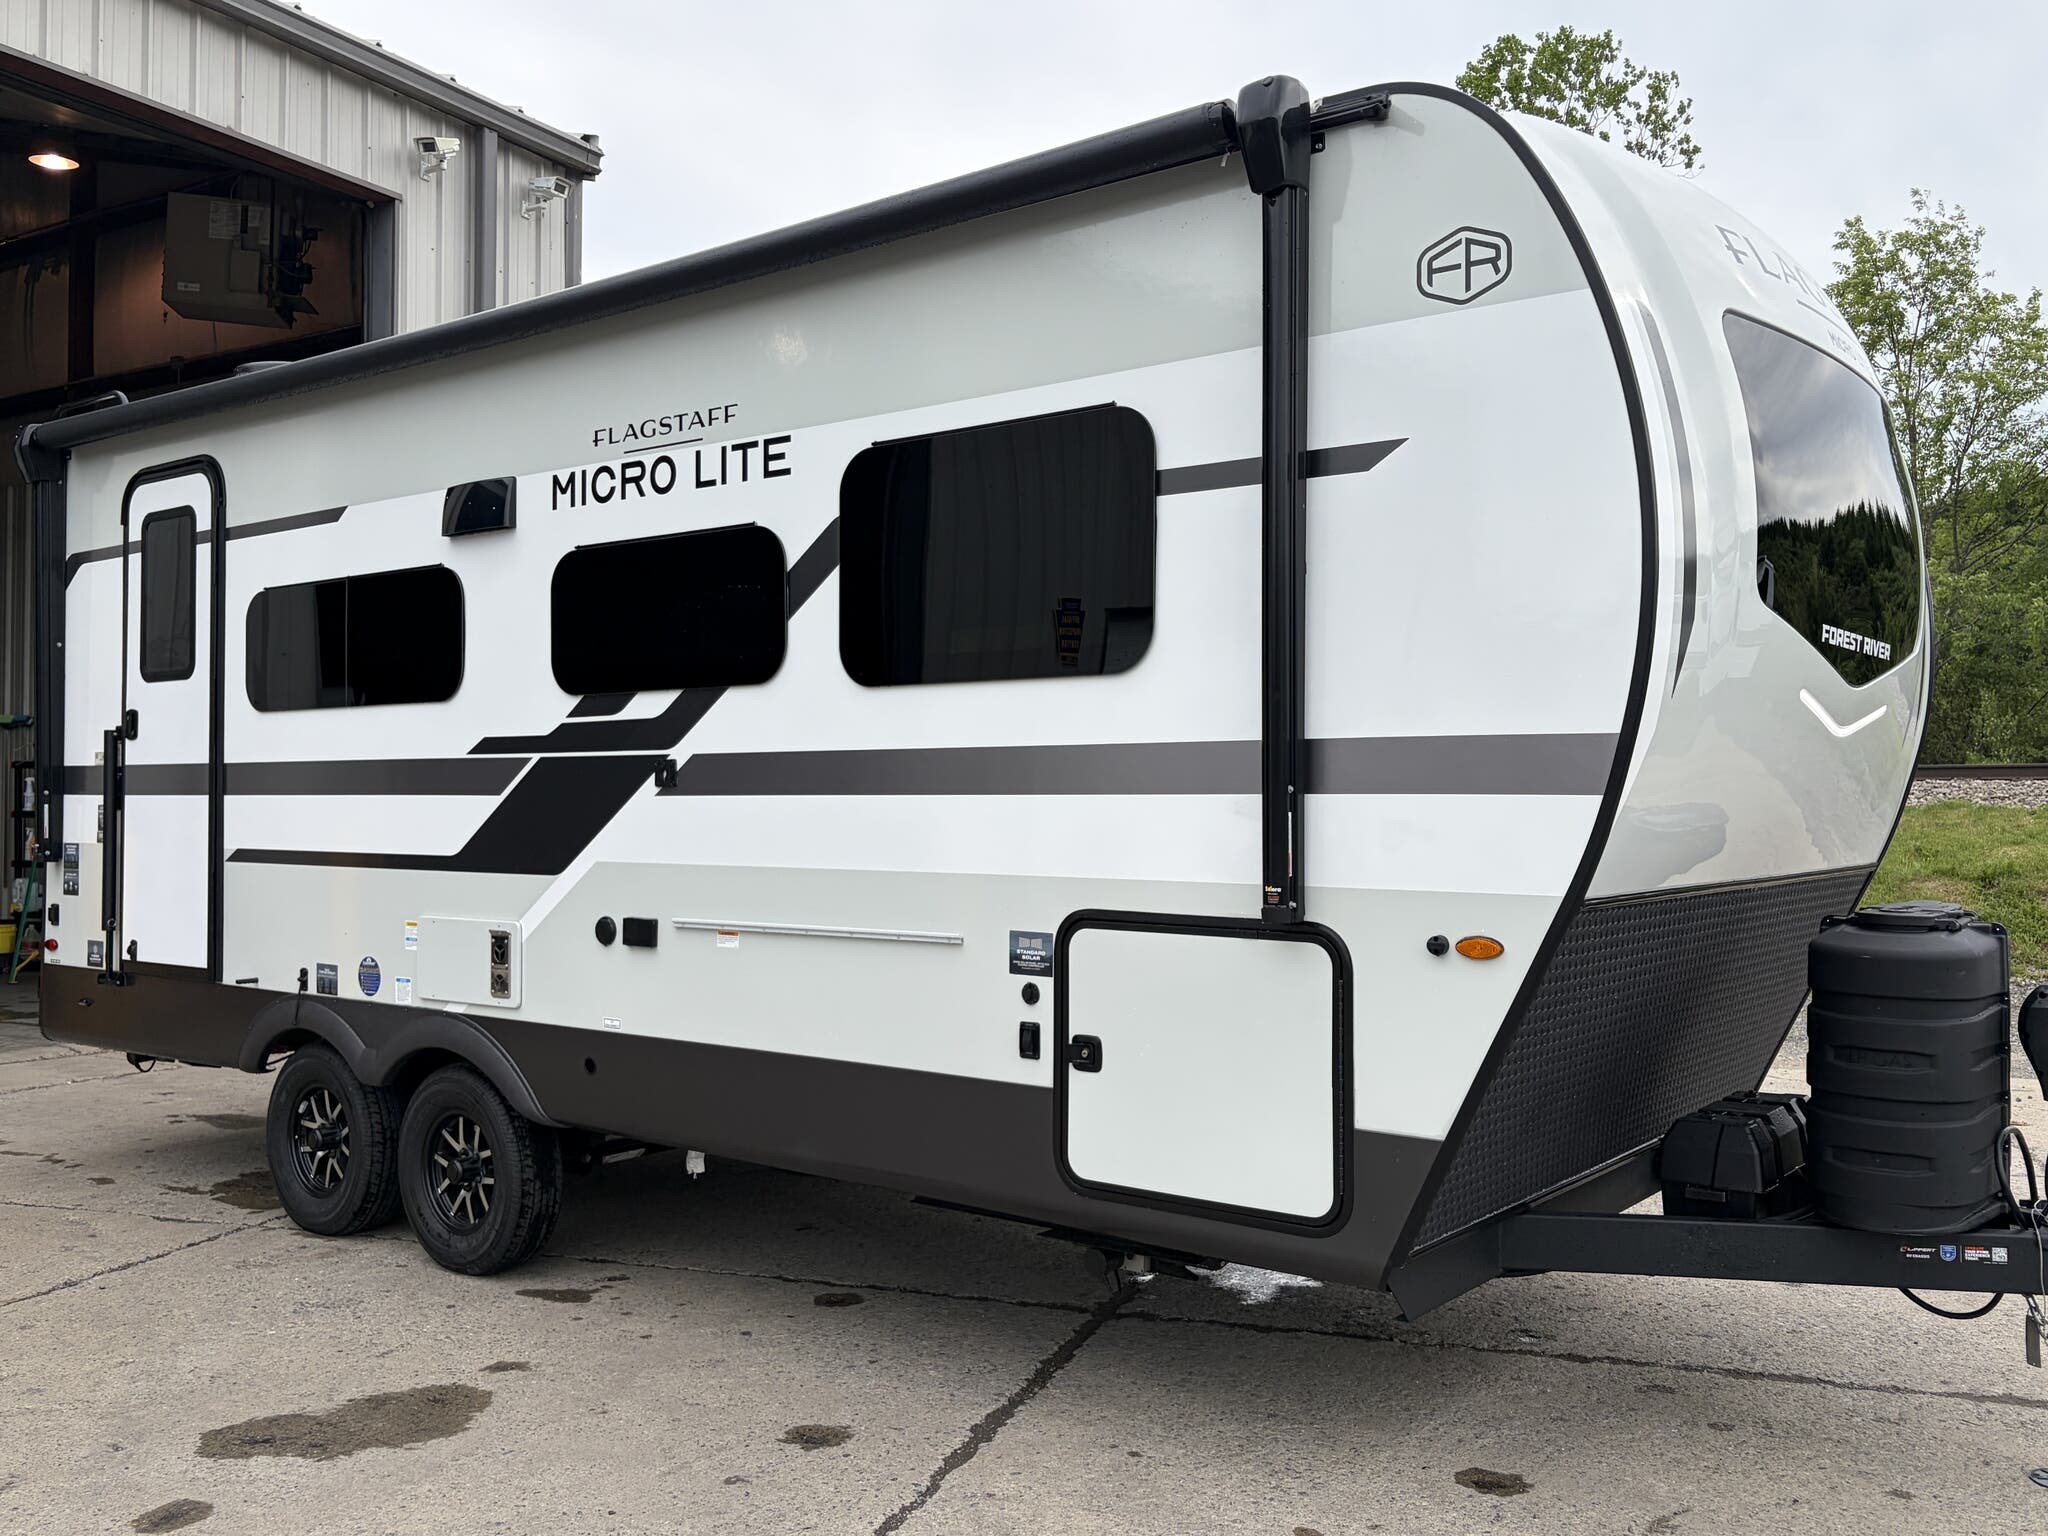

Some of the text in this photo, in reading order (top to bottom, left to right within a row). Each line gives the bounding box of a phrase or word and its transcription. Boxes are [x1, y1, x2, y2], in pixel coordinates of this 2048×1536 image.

[592, 403, 738, 447] FLAGSTAFF
[551, 434, 791, 511] MICRO LITE
[1821, 623, 1892, 661] FOREST RIVER
